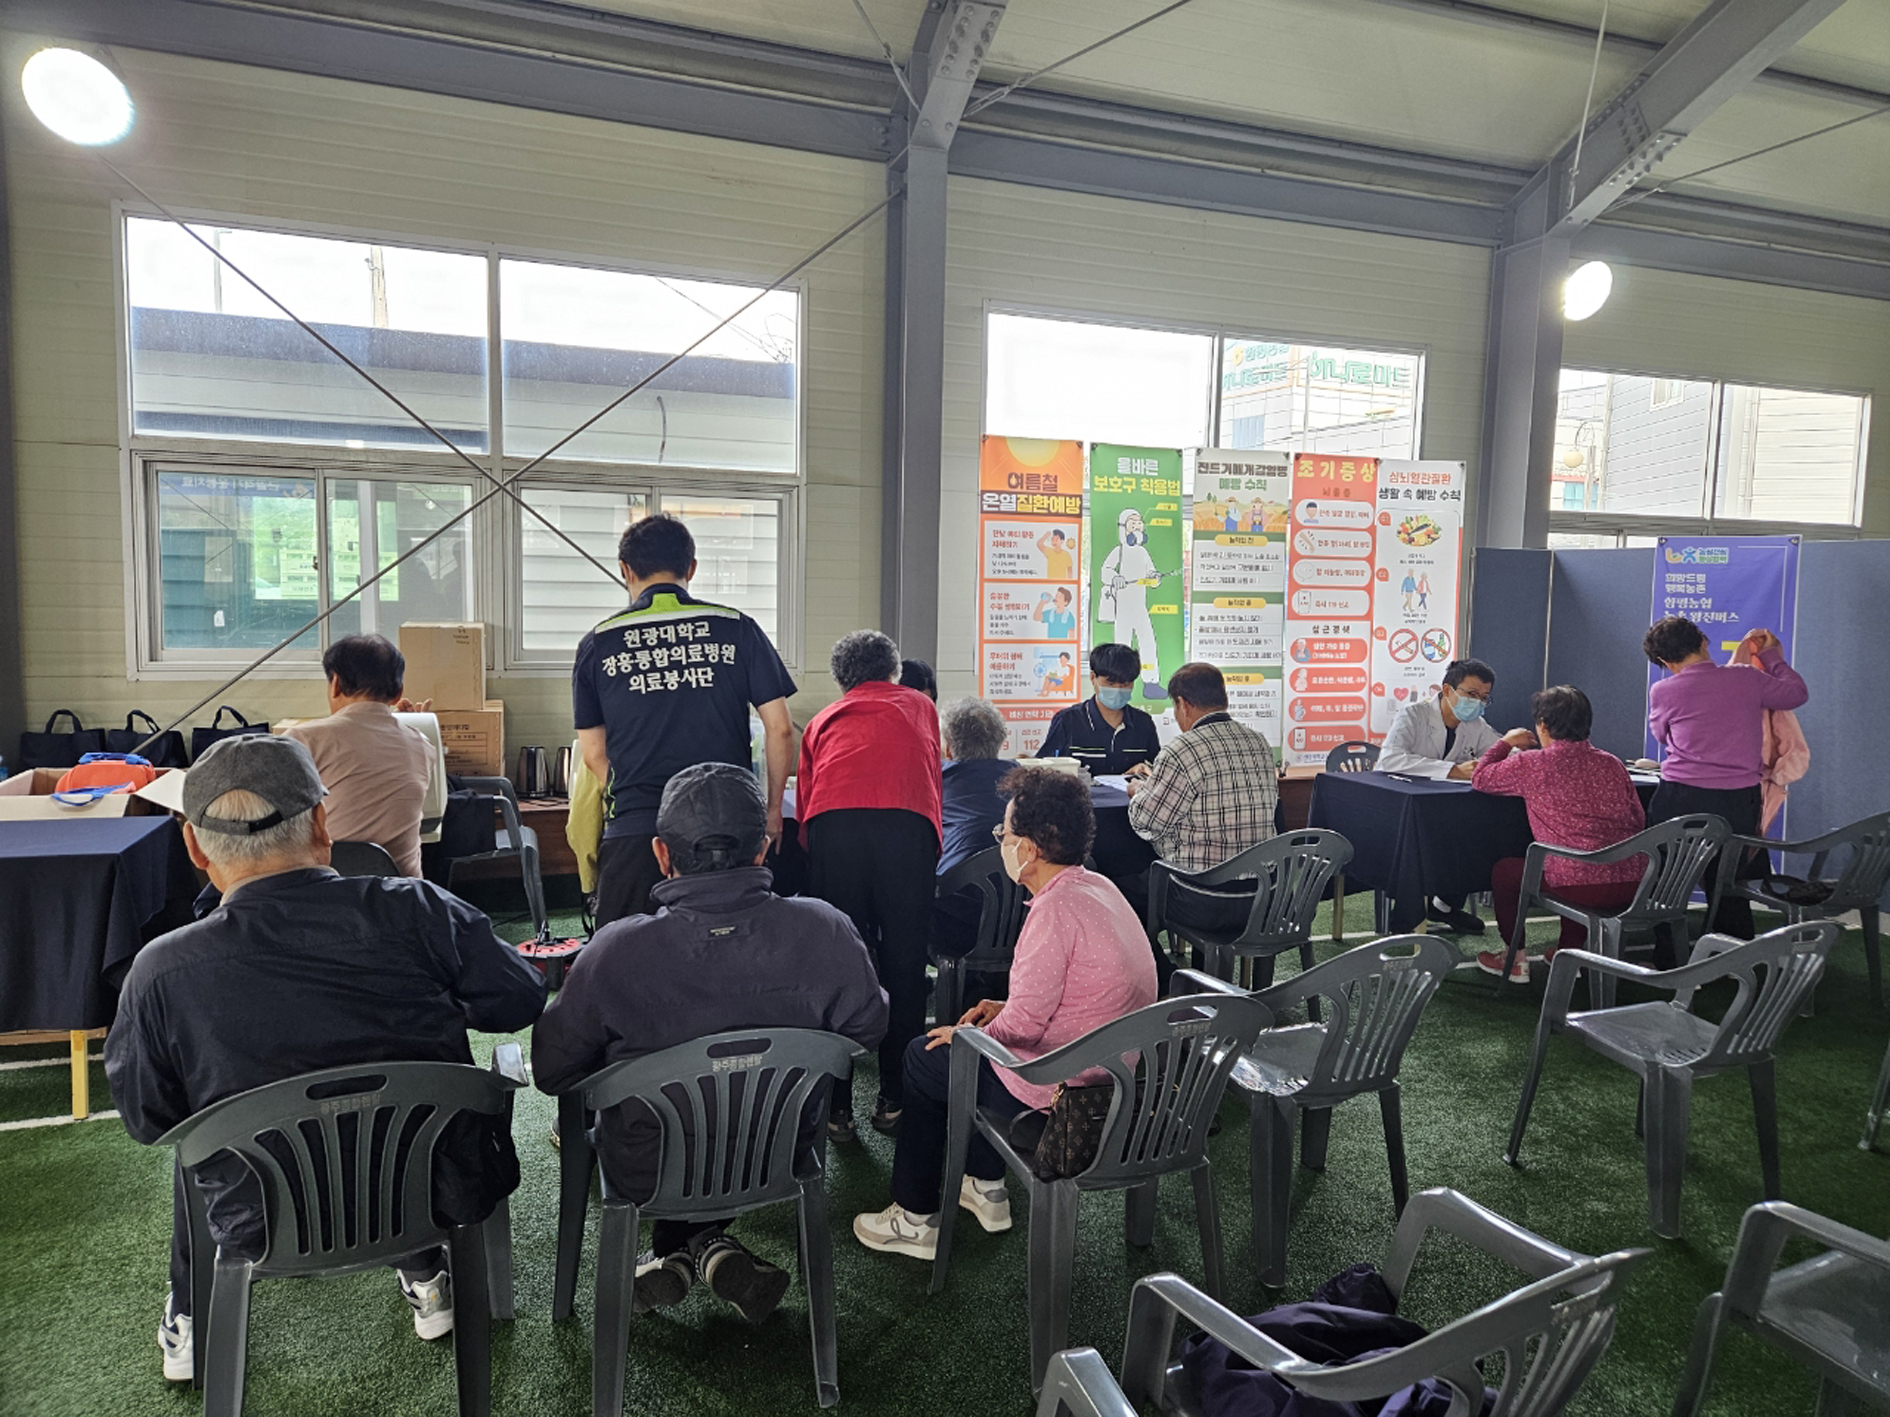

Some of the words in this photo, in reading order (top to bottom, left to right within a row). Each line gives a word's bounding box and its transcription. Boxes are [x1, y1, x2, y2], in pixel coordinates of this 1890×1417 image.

[1309, 351, 1410, 389] 하나로마트
[1117, 457, 1158, 476] 올바른
[1007, 472, 1058, 492] 여름철
[1094, 475, 1136, 493] 보호구
[1140, 479, 1180, 497] 착용법
[1245, 478, 1267, 491] 수칙
[982, 492, 1081, 515] 온열질환예방
[1379, 488, 1400, 500] 생활
[1403, 488, 1413, 500] 속
[1416, 488, 1437, 501] 예방
[1440, 489, 1461, 501] 수칙
[623, 621, 711, 648] 원광대학교
[602, 643, 736, 678] 장흥통합의료병원
[629, 667, 715, 694] 의료봉사단
[1024, 739, 1040, 751] 112
